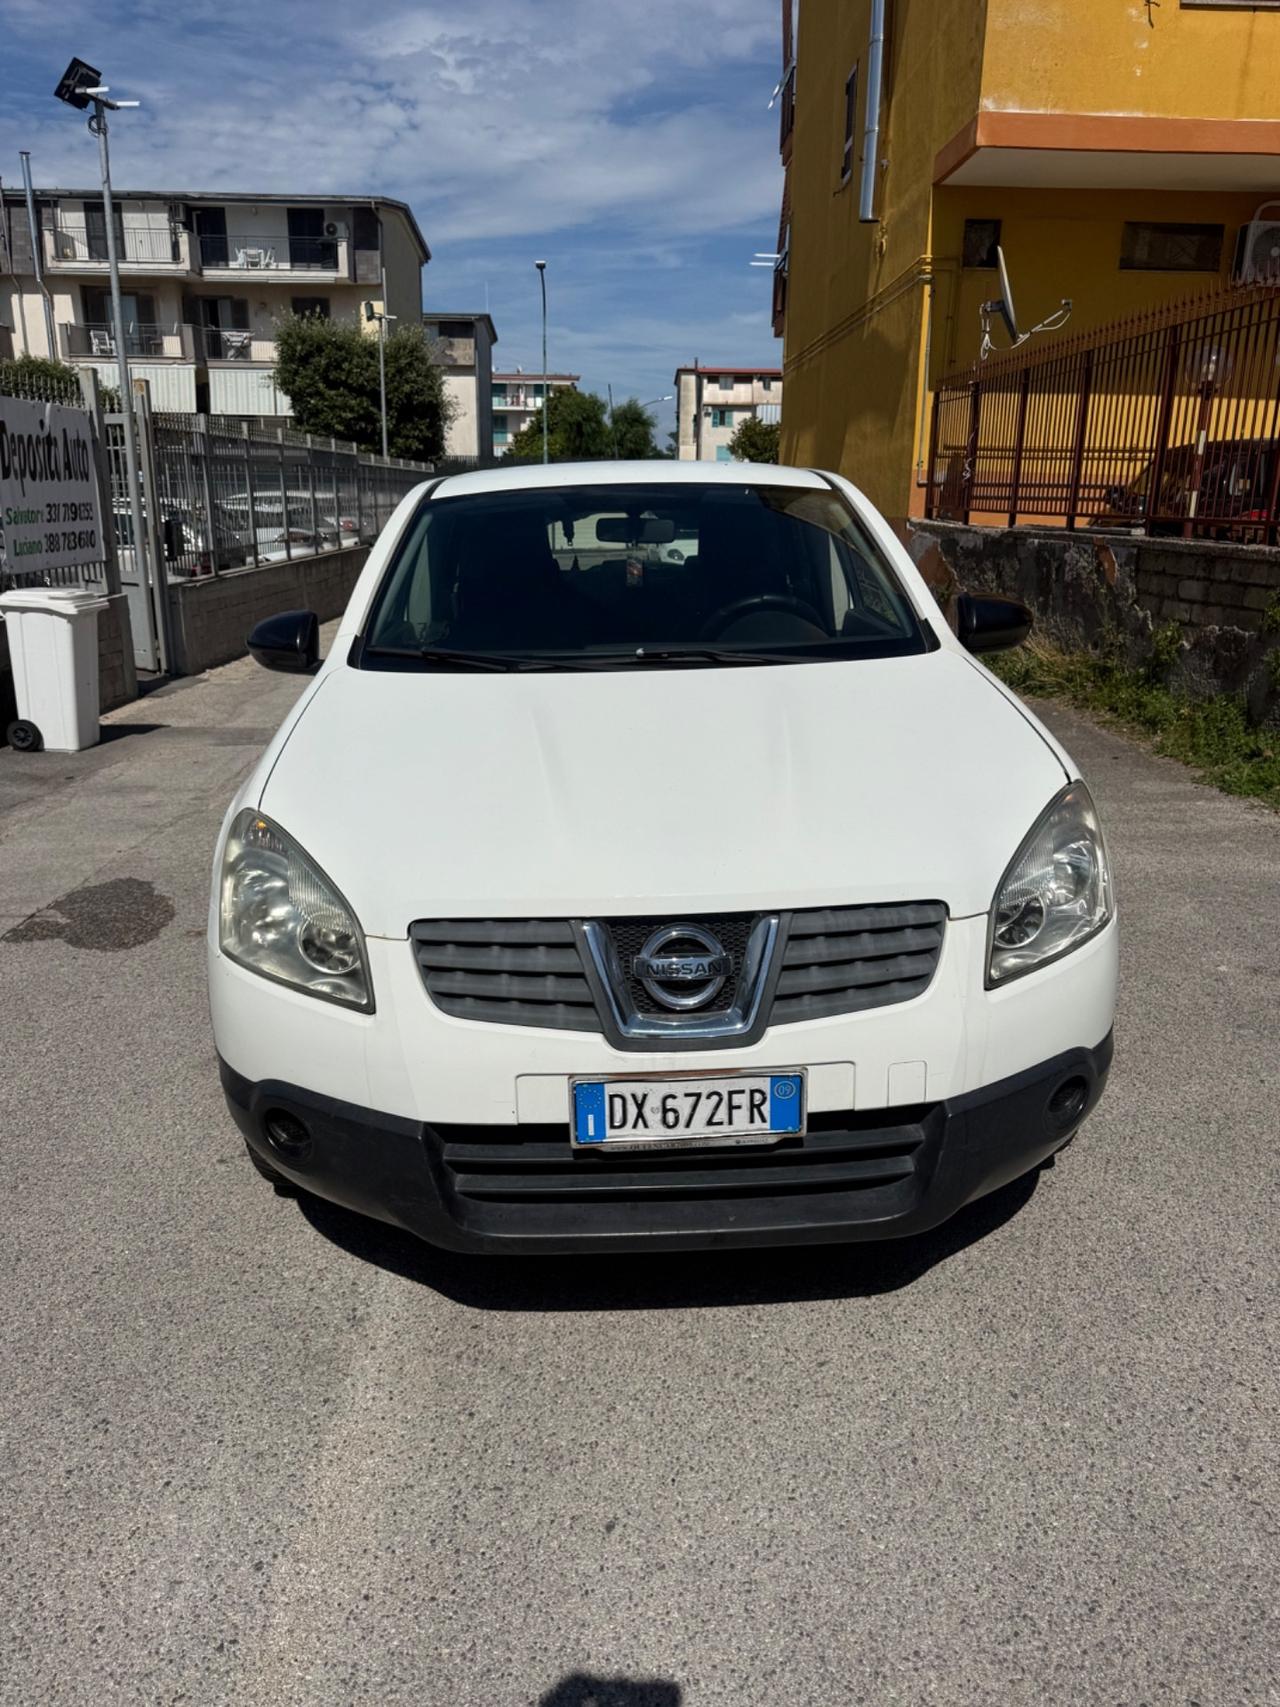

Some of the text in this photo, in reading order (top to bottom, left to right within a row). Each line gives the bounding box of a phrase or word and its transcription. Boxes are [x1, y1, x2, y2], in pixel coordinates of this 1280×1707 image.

[63, 428, 90, 482] Auto
[646, 961, 722, 976] NISSAN
[608, 1088, 768, 1130] DX 672FR
